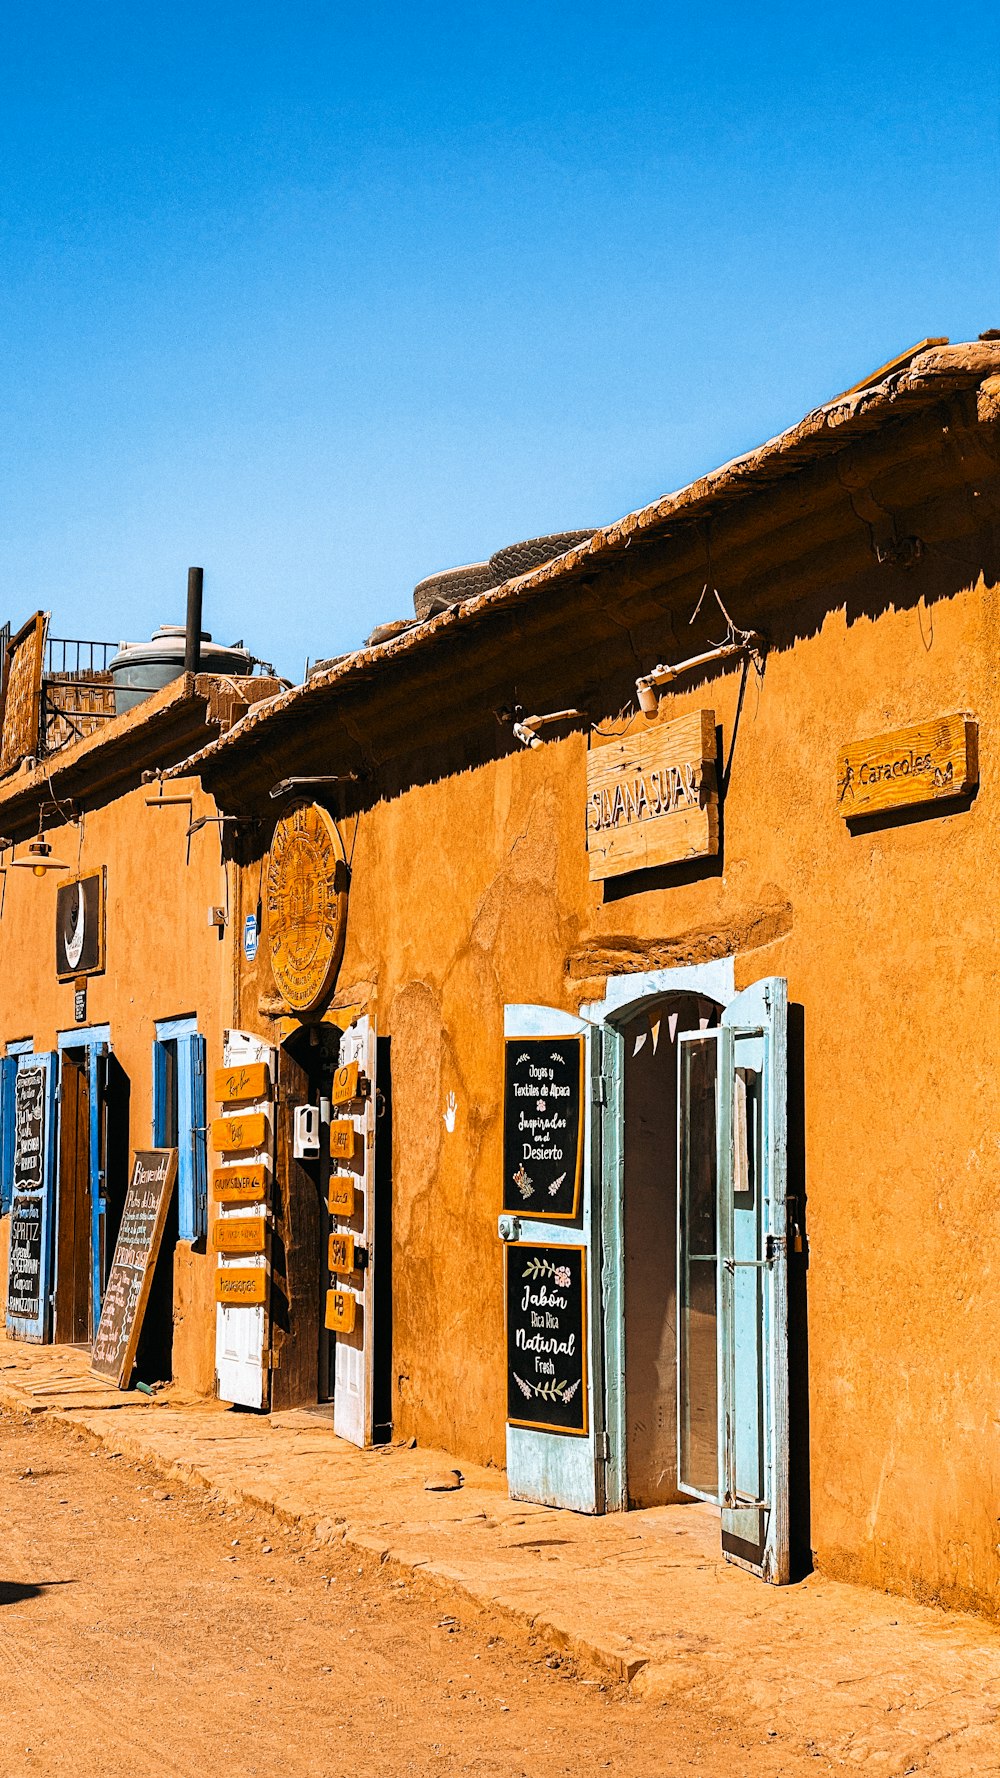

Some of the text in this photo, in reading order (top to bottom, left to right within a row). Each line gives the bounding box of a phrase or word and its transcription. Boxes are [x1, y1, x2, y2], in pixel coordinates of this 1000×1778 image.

[859, 751, 932, 785] Caracoles
[591, 763, 698, 829] SILVANA SUTAR
[529, 1064, 554, 1081] Joyas y
[513, 1083, 570, 1099] Textiles de Alpaca
[518, 1111, 567, 1136] Inspirados
[534, 1132, 550, 1142] en el
[522, 1143, 563, 1160] Desierto
[215, 1177, 250, 1190] QUIKSILVER
[13, 1221, 39, 1241] SPRITZ
[14, 1272, 33, 1298] Campari
[220, 1277, 257, 1295] havaianas
[521, 1285, 568, 1311] Jabón
[531, 1311, 559, 1329] Rica Rica
[516, 1328, 576, 1356] Natural
[535, 1356, 555, 1375] Fresh
